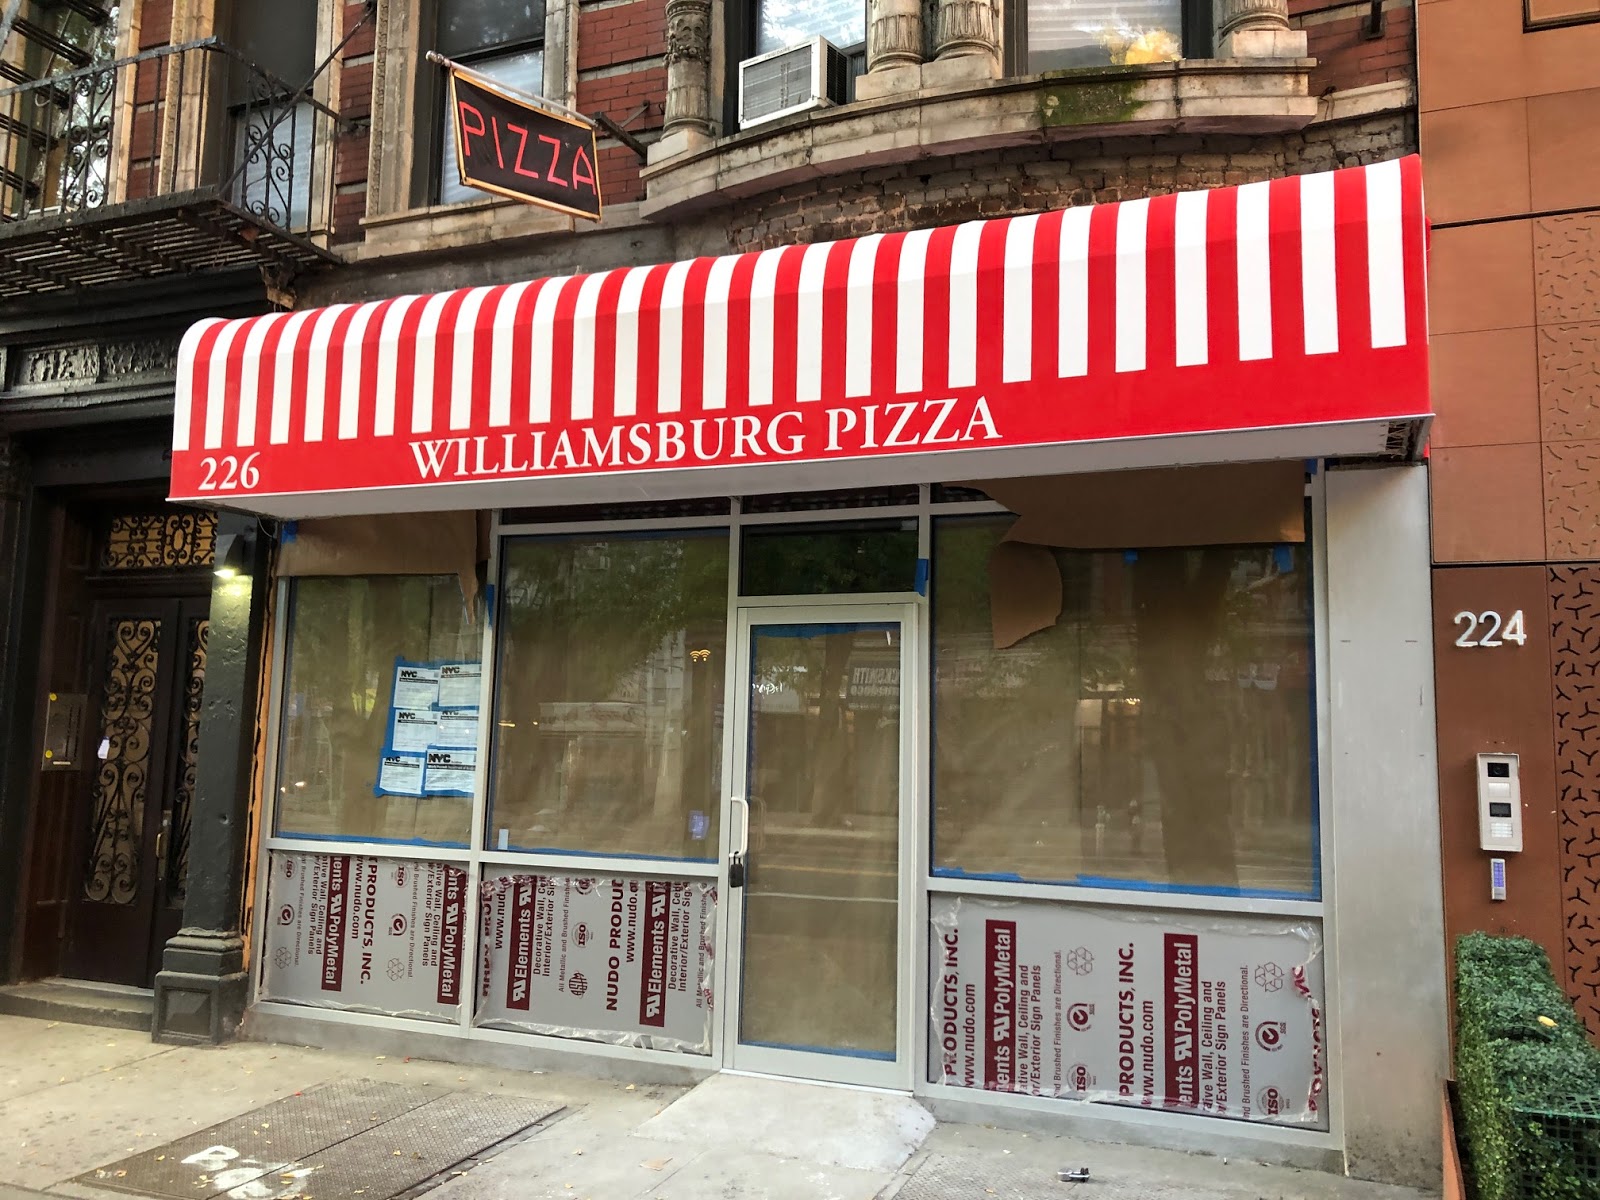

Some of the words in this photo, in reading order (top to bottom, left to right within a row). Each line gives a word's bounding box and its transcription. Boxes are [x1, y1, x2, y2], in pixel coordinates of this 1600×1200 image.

[459, 101, 597, 195] PIZZA
[408, 411, 806, 479] WILLIAMSBURG
[824, 395, 1003, 451] PIZZA
[198, 451, 261, 491] 226
[1454, 610, 1527, 647] 224
[442, 666, 460, 674] NYC
[428, 754, 451, 763] NYC
[319, 880, 328, 902] Wall,
[396, 866, 405, 886] ISO
[309, 903, 318, 923] Sign
[362, 864, 378, 949] PRODUCTS,
[434, 890, 442, 911] Wall,
[536, 897, 547, 920] Wall,
[316, 905, 326, 937] Ceiling
[423, 912, 433, 934] Sign
[431, 914, 441, 948] Ceiling
[561, 911, 569, 937] Brushed
[578, 924, 586, 946] ISO
[671, 907, 682, 933] Wall,
[308, 925, 316, 955] Panels
[315, 939, 323, 955] and
[325, 915, 341, 984] PolyMetal
[422, 936, 431, 967] Panels
[515, 908, 531, 978] Elements
[533, 924, 544, 975] Decorative
[542, 899, 554, 977] Interior/Exterior
[678, 910, 690, 992] Interior/Exterior
[944, 928, 959, 970] INC.
[360, 953, 372, 985] INC.
[442, 925, 459, 998] PolyMetal
[559, 953, 567, 981] Metallic
[648, 920, 665, 993] Elements
[668, 935, 679, 990] Decorative
[994, 928, 1014, 1017] PolyMetal
[1119, 942, 1134, 984] INC.
[606, 955, 620, 1011] NUDO
[1020, 965, 1029, 985] and
[1030, 965, 1042, 1003] Panels
[1174, 942, 1196, 1033] PolyMetal
[1202, 981, 1212, 1003] and
[1240, 965, 1249, 1013] Directional.
[1018, 988, 1031, 1029] Ceiling
[1054, 997, 1062, 1011] are
[1215, 981, 1226, 1020] Panels
[943, 971, 959, 1076] PRODUCTS,
[1030, 1004, 1043, 1032] Sign
[1053, 1012, 1062, 1046] Finishes
[1202, 1007, 1215, 1048] Ceiling
[1242, 1014, 1250, 1029] are
[1018, 1029, 1030, 1057] Wall,
[1119, 987, 1136, 1096] PRODUCTS,
[1215, 1024, 1228, 1051] Sign
[1241, 1031, 1250, 1066] Finishes
[1053, 1047, 1062, 1082] Brushed
[1076, 1066, 1086, 1092] ISO
[1202, 1052, 1215, 1080] Wall,
[1241, 1068, 1251, 1104] Brushed
[1267, 1088, 1278, 1115] ISO
